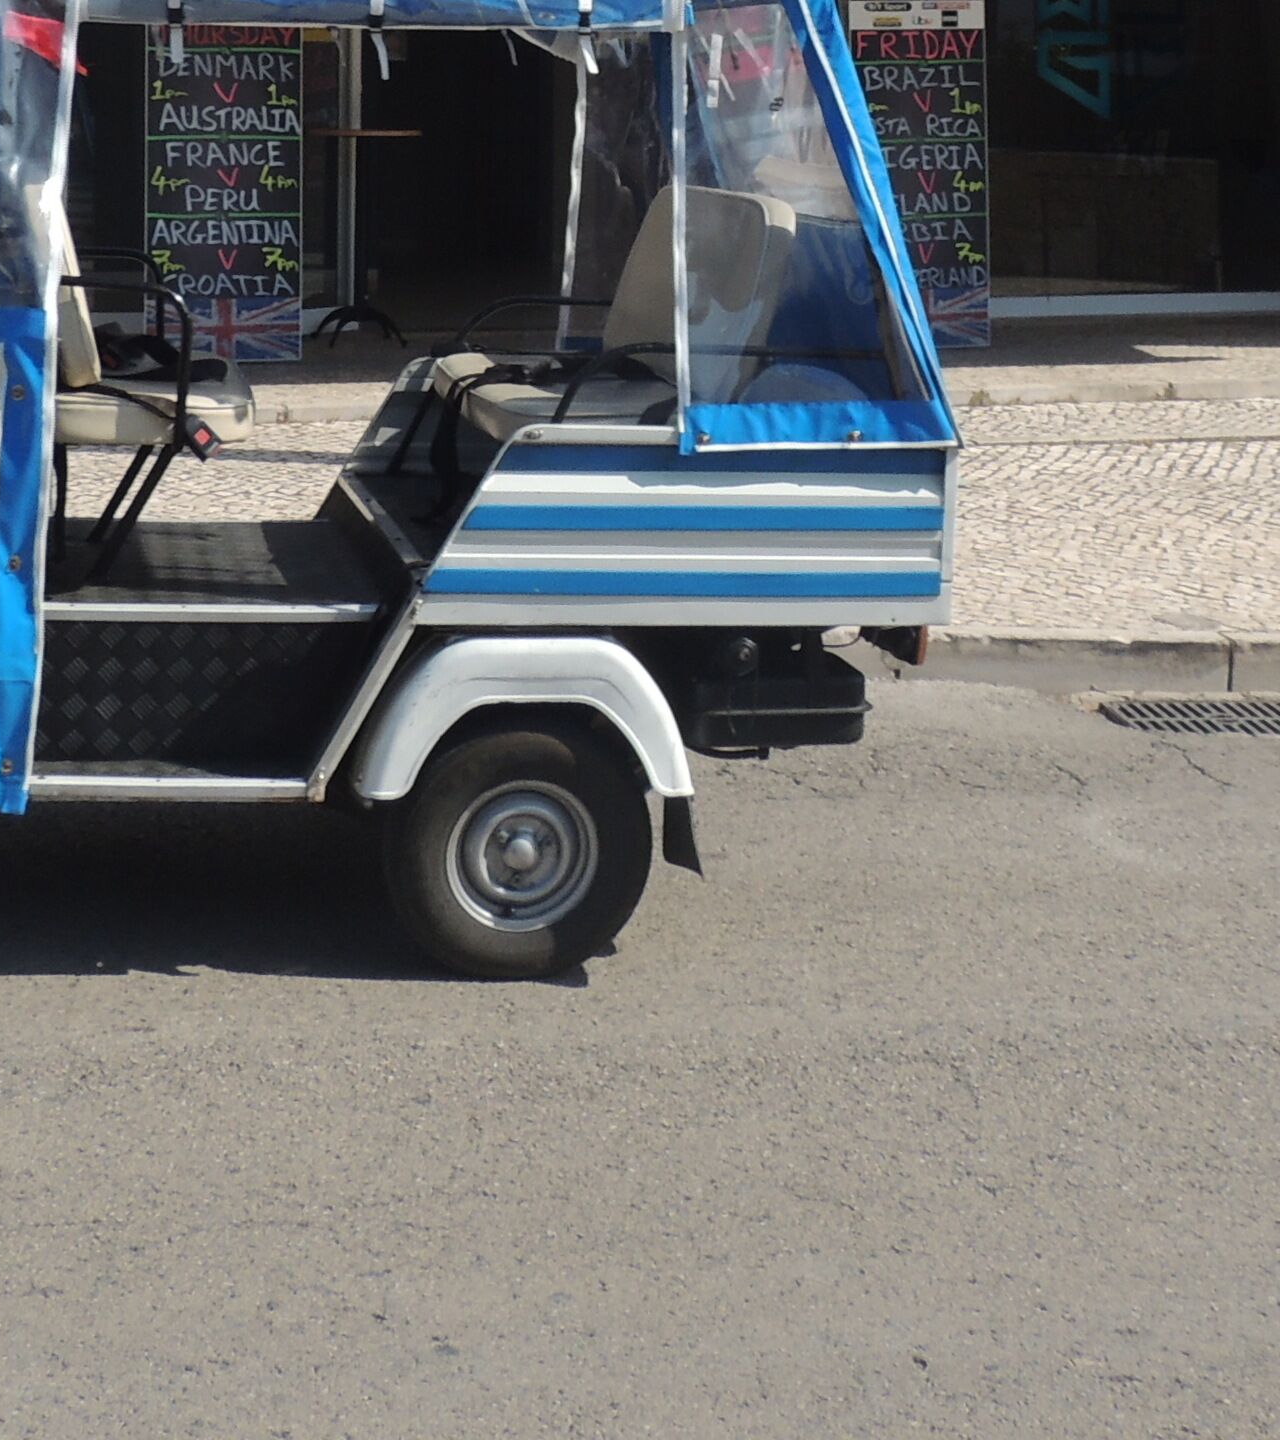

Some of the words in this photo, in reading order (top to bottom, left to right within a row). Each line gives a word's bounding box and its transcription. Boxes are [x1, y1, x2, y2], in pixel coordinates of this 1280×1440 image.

[856, 30, 979, 59] FRIDAY
[160, 52, 294, 82] DENMARK
[863, 65, 981, 92] BRAZIL
[159, 103, 301, 134] AUSTRALIA
[875, 116, 911, 136] STA
[926, 114, 982, 137] RICA
[166, 141, 285, 168] FRANCE
[881, 143, 984, 170] IGERIA
[184, 185, 260, 211] PERU
[896, 192, 972, 216] LAND
[151, 220, 298, 247] ARGENTINA
[902, 218, 974, 242] BIA
[916, 265, 987, 288] ERLAND
